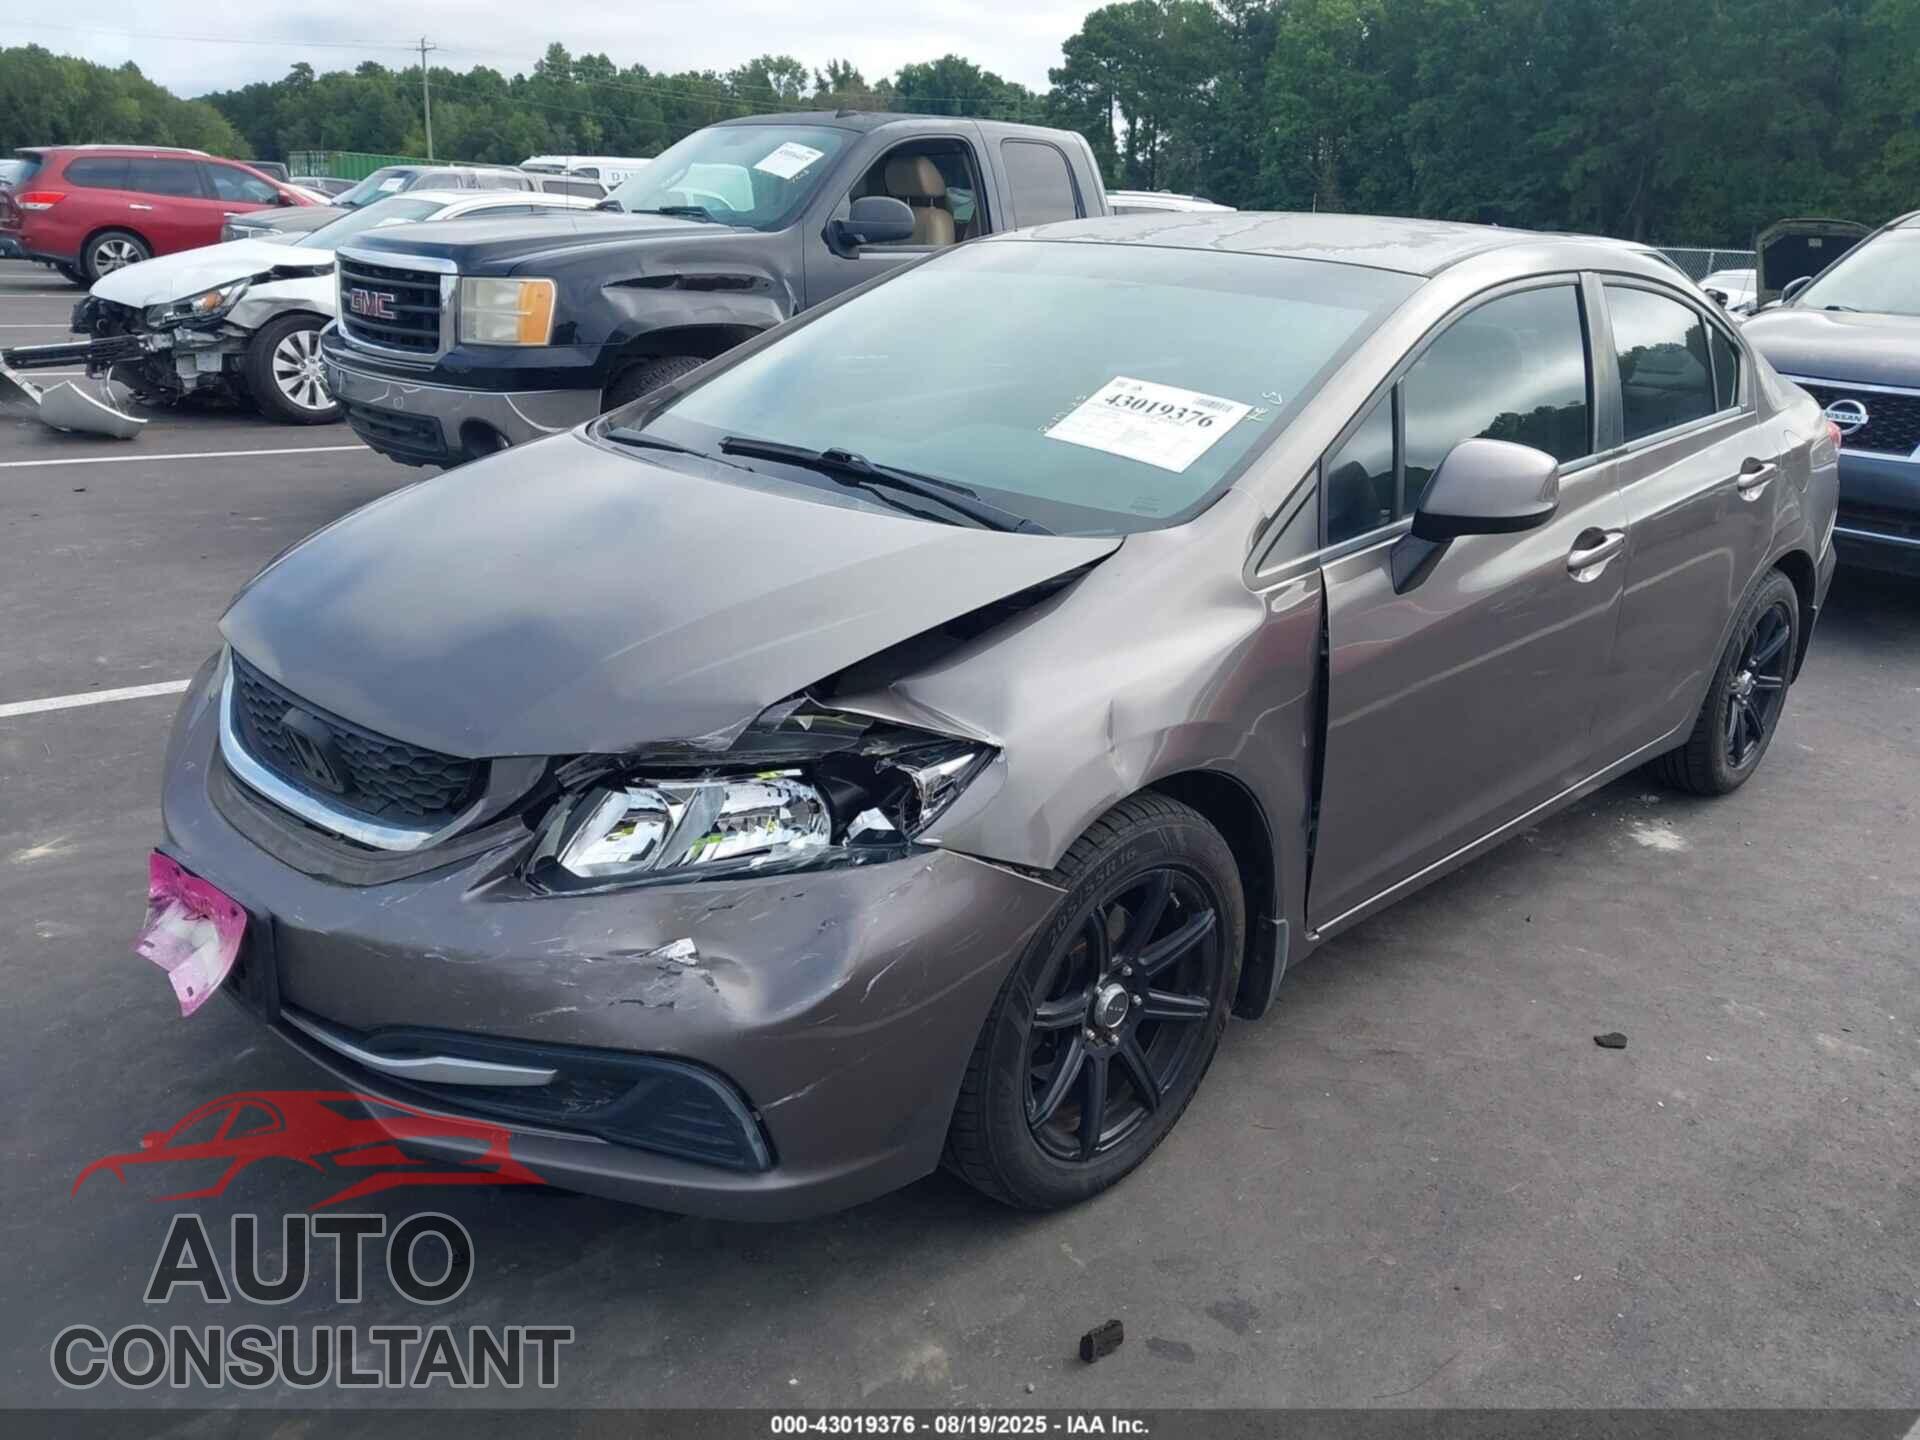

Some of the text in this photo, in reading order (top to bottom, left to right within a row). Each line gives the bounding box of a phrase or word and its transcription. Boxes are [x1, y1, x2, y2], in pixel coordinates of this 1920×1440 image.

[351, 288, 397, 320] GMC
[1104, 393, 1214, 429] 43019376
[1825, 411, 1863, 422] NISSAN
